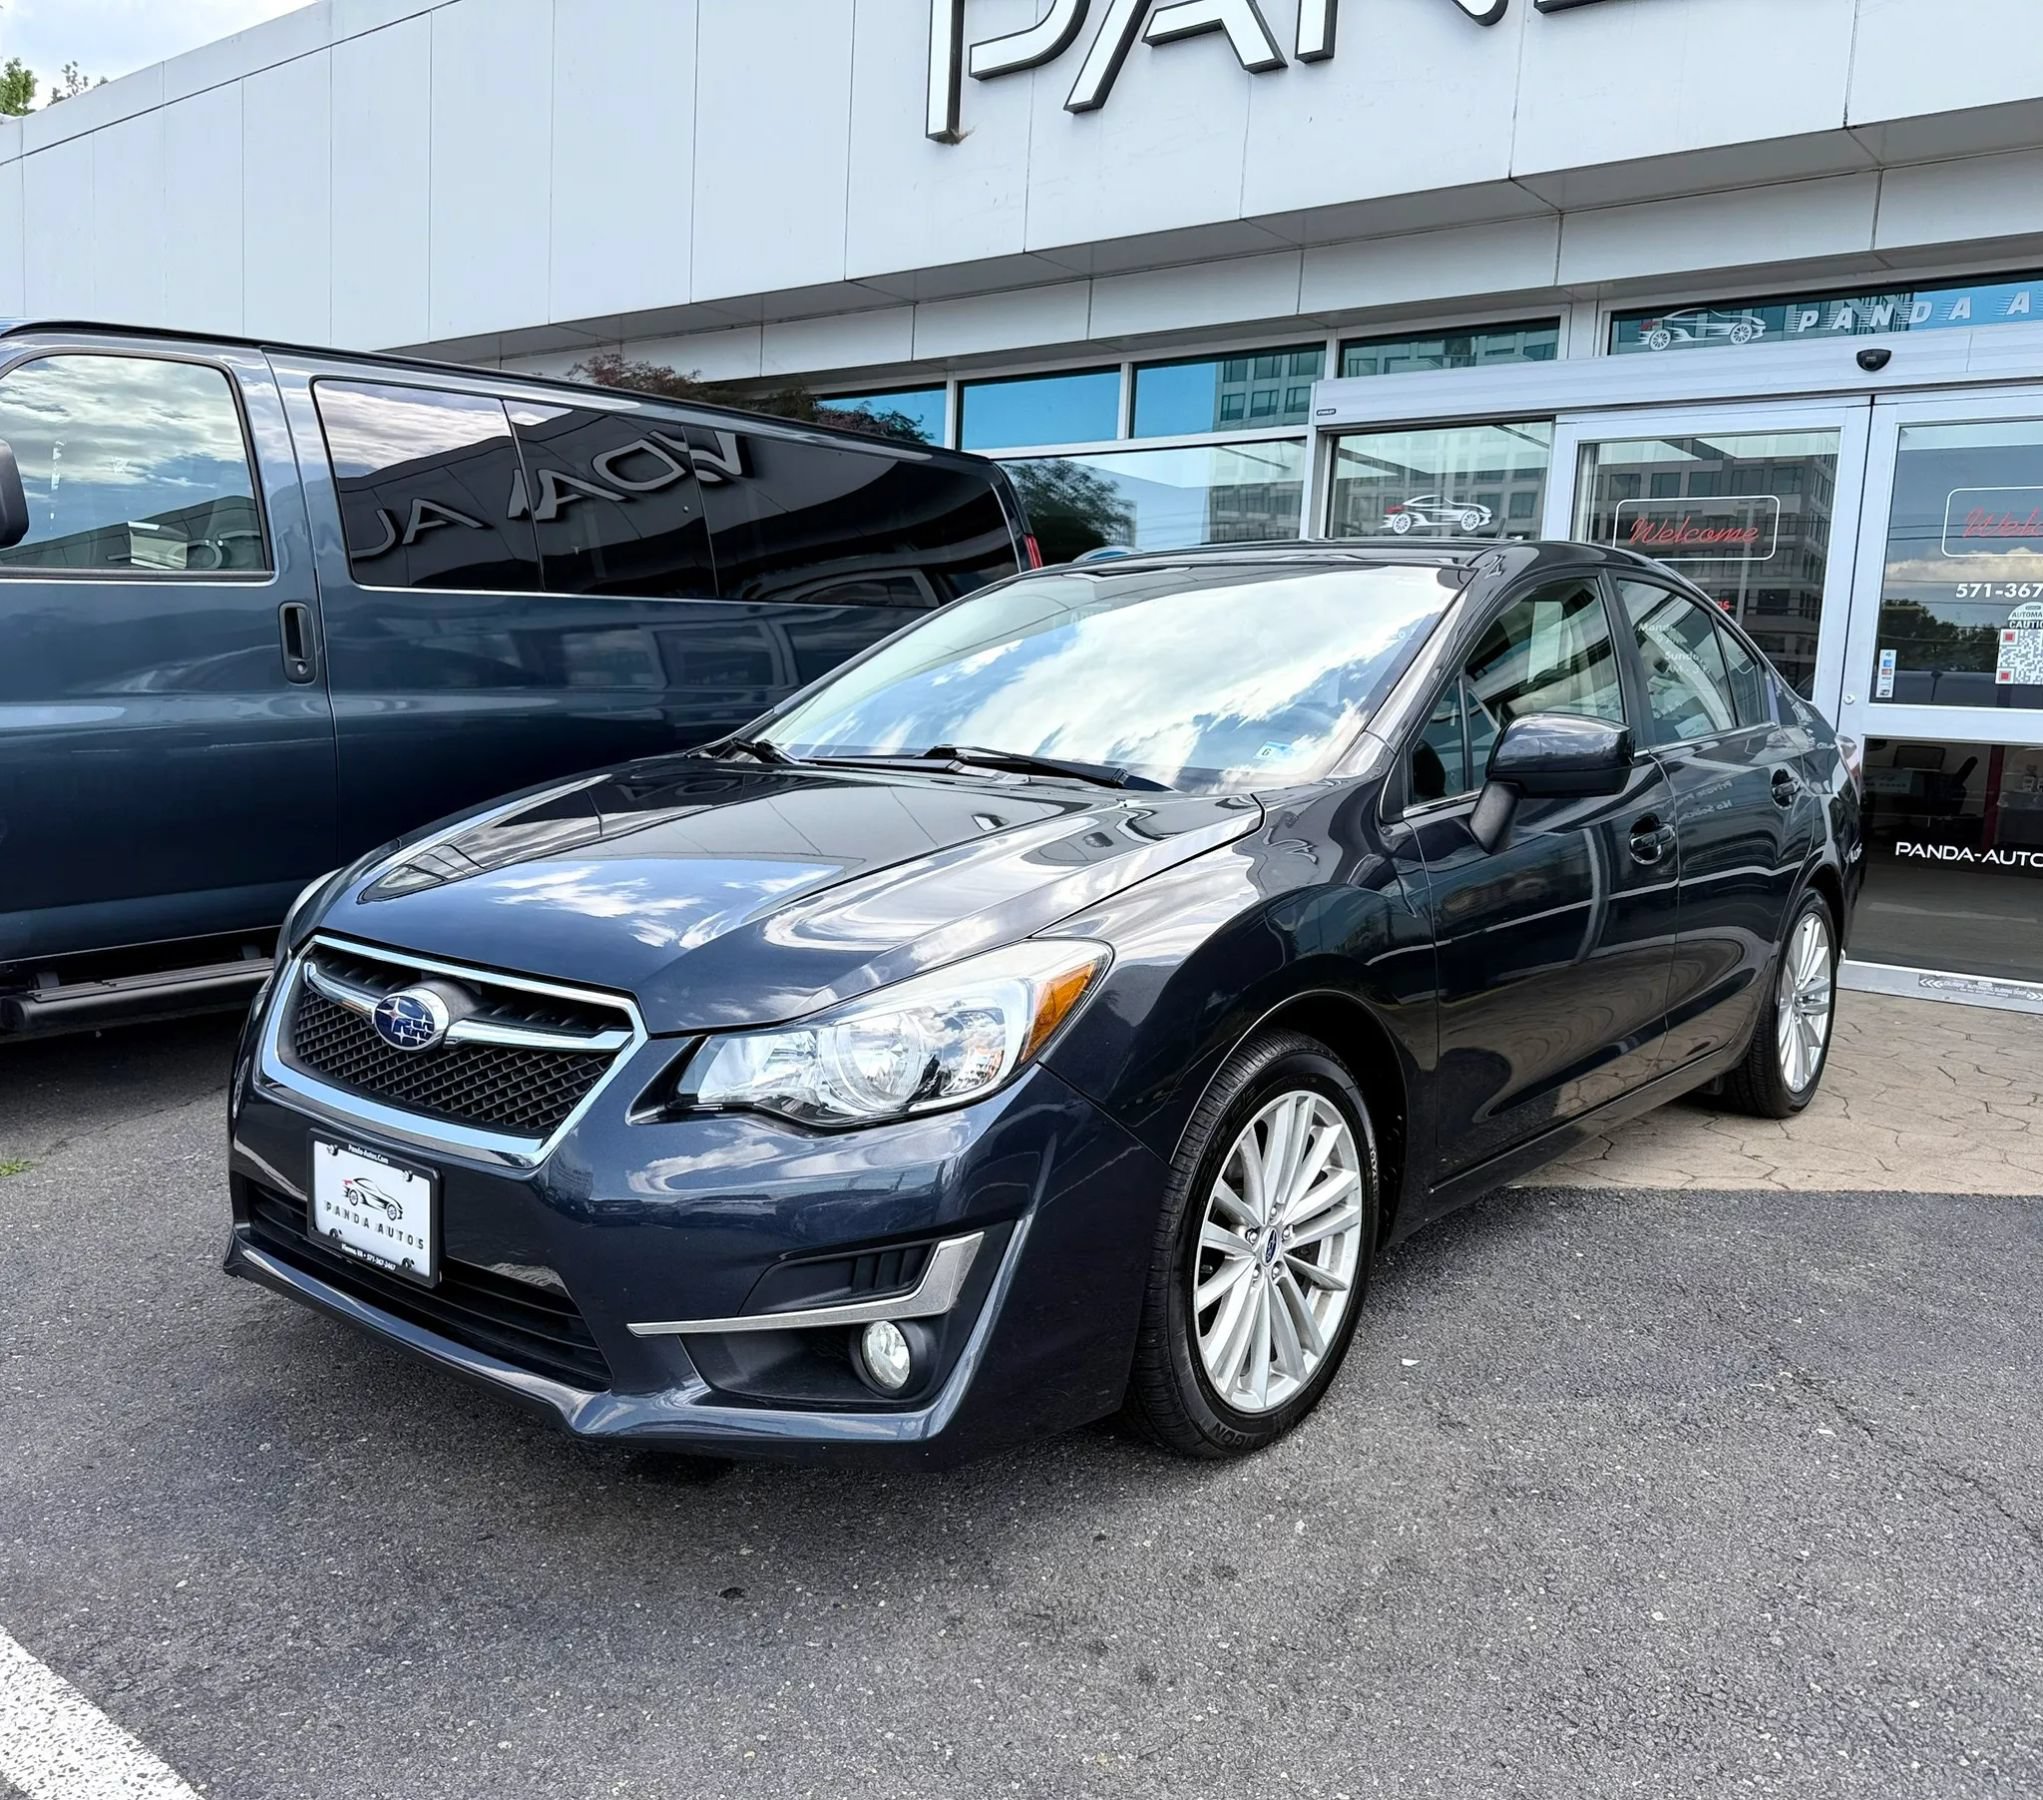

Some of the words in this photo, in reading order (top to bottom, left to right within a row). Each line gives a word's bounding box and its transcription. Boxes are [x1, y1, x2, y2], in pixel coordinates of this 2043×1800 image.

[1797, 295, 1971, 332] PANDA
[1629, 515, 1760, 545] Welcome
[1955, 583, 2043, 598] 571-367
[325, 1200, 370, 1229] PANDA
[377, 1223, 424, 1250] AUTOS
